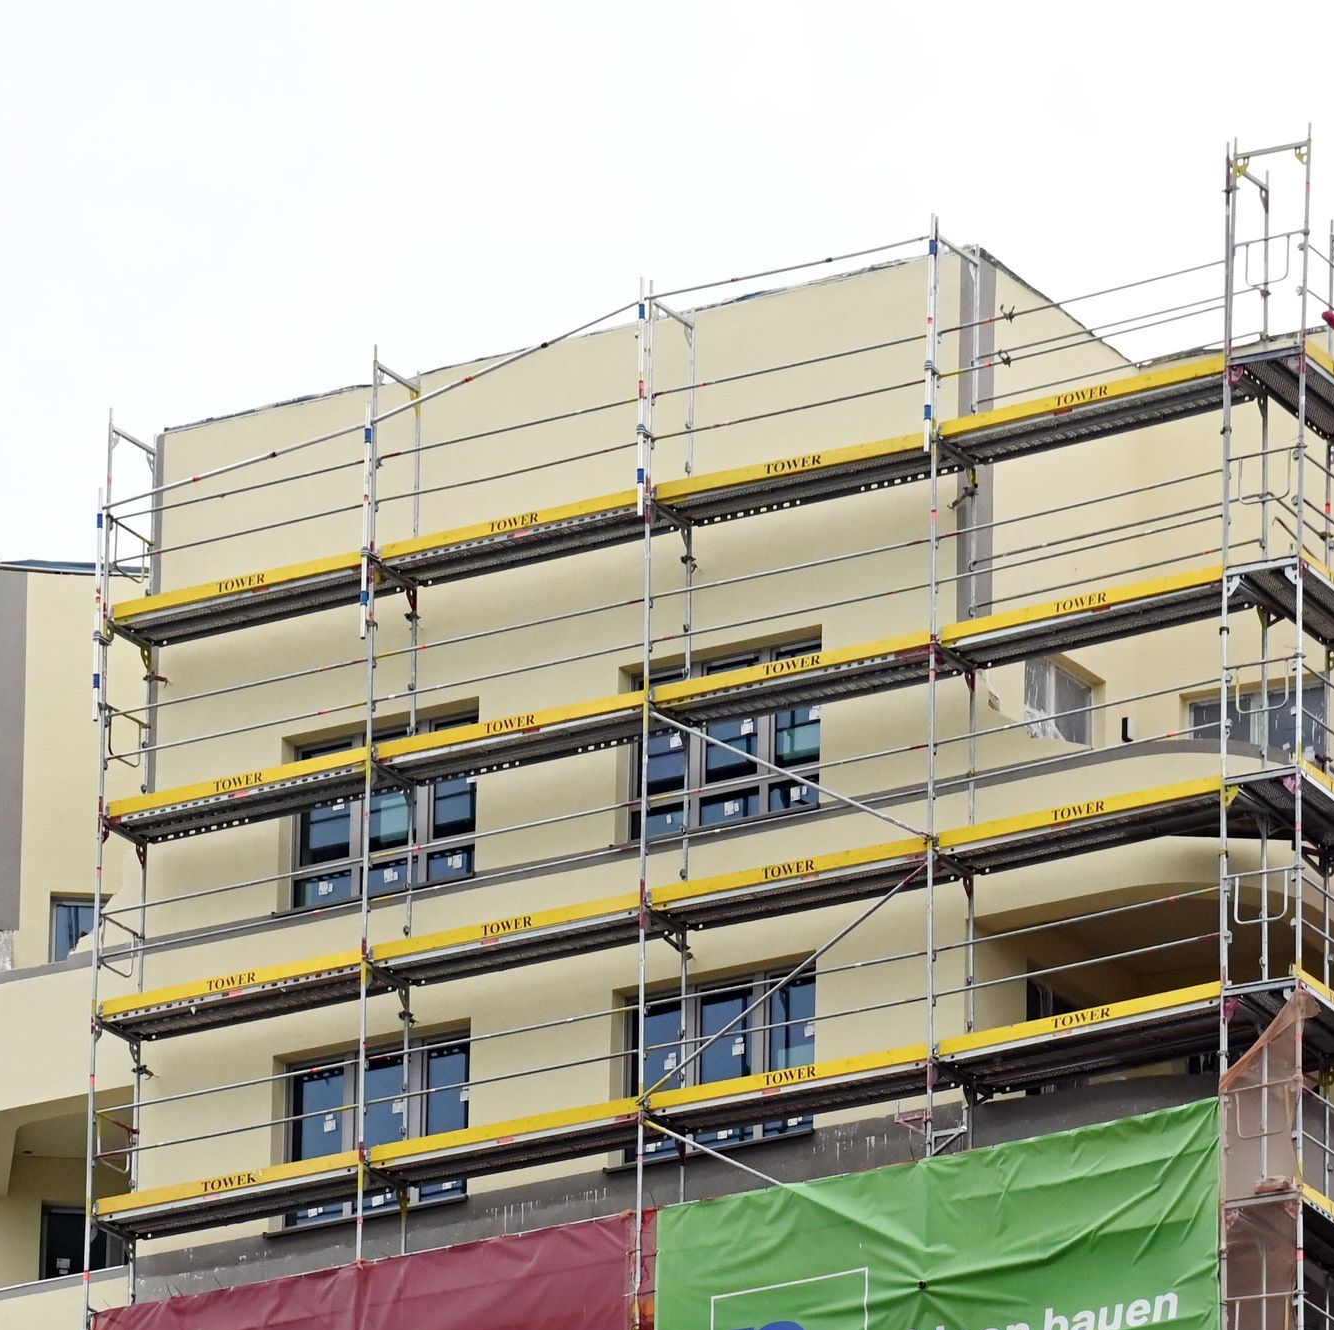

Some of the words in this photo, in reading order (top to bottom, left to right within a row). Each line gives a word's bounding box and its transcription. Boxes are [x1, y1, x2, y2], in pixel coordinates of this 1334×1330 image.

[1055, 385, 1108, 406] TOWER
[765, 455, 821, 473] TOWER
[489, 512, 538, 531] TOWER
[217, 573, 265, 593] TOWER
[1054, 592, 1107, 612] TOWER
[764, 654, 820, 674] TOWER
[485, 714, 536, 733] TOWER
[214, 771, 262, 791] TOWER
[1052, 800, 1105, 820] TOWER
[763, 859, 815, 879] TOWER
[482, 916, 532, 935] TOWER
[207, 971, 256, 990] TOWER
[1053, 1006, 1110, 1027] TOWER
[764, 1065, 816, 1084] TOWER
